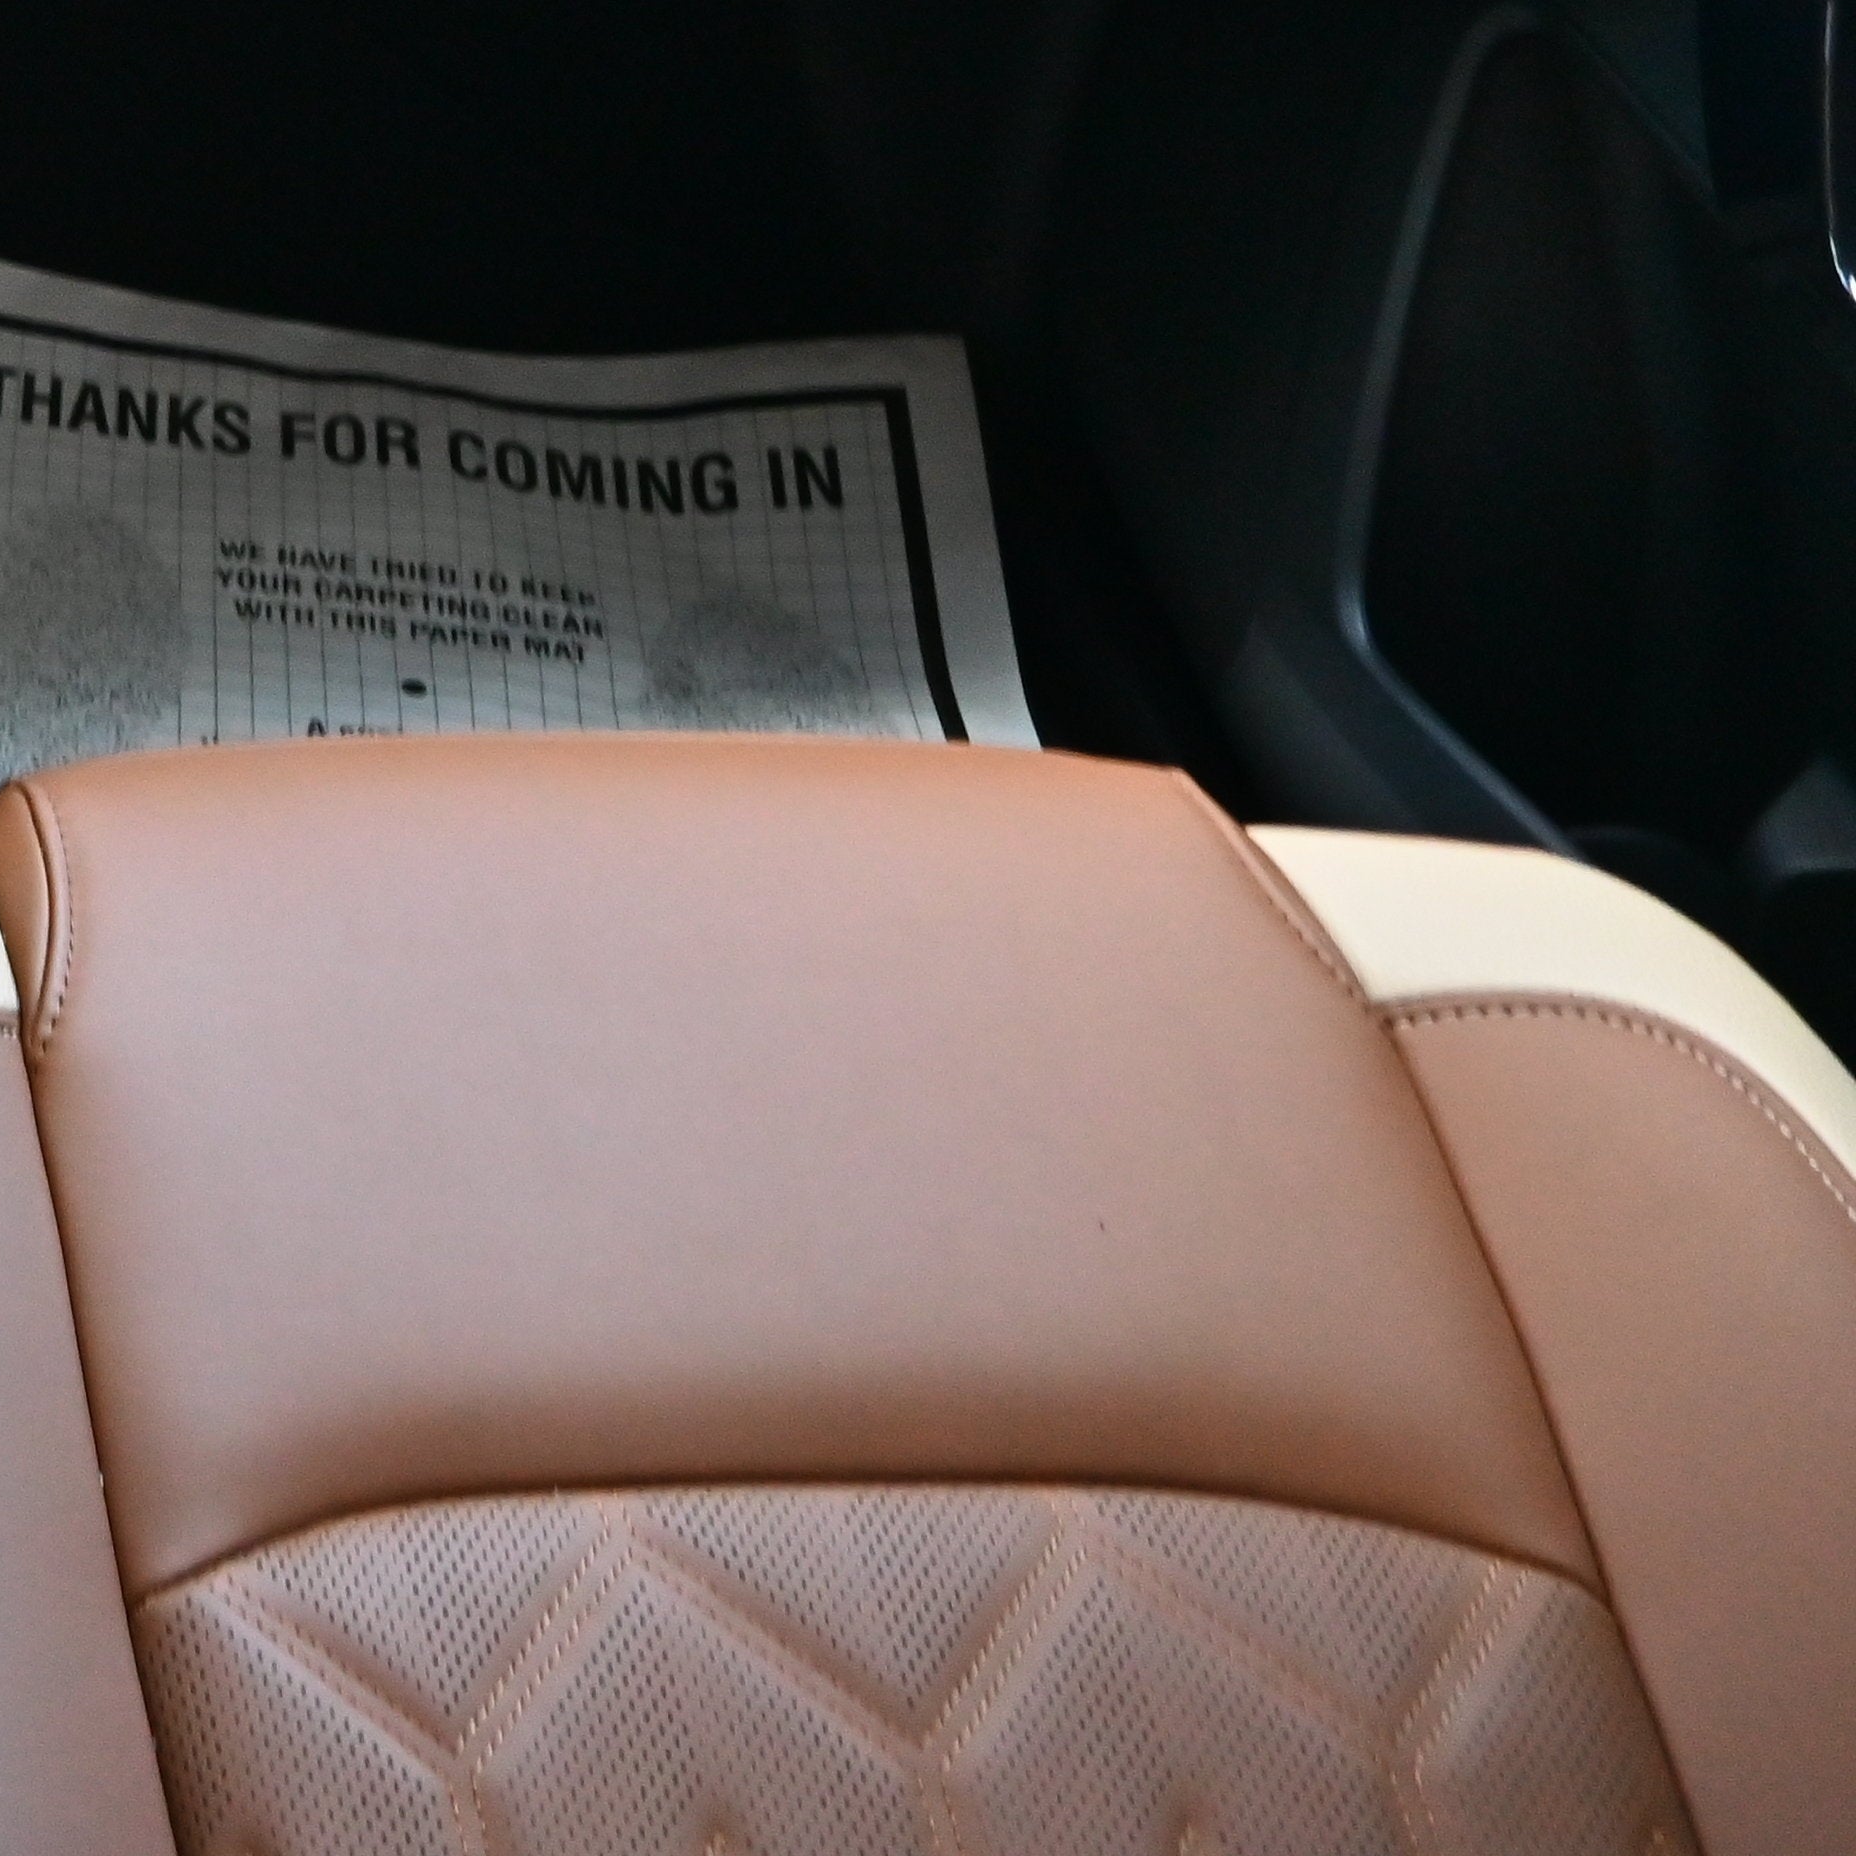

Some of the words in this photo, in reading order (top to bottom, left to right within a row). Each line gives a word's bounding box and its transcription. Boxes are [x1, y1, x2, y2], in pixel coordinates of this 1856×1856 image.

[278, 410, 423, 469] FOR
[447, 427, 739, 516] COMING
[767, 443, 843, 509] IN
[215, 566, 302, 596] YOUR
[314, 578, 491, 623] CARPETING
[502, 603, 604, 640] CLEAN
[219, 539, 263, 560] WE
[276, 545, 357, 573] HAVE
[371, 557, 457, 586] TRIED
[473, 568, 508, 595] TO
[520, 576, 597, 607] KEEP
[233, 597, 314, 627] WITH
[329, 607, 398, 640] THIS
[409, 618, 511, 653] PAPER
[522, 632, 585, 663] MAT
[306, 716, 326, 737] A
